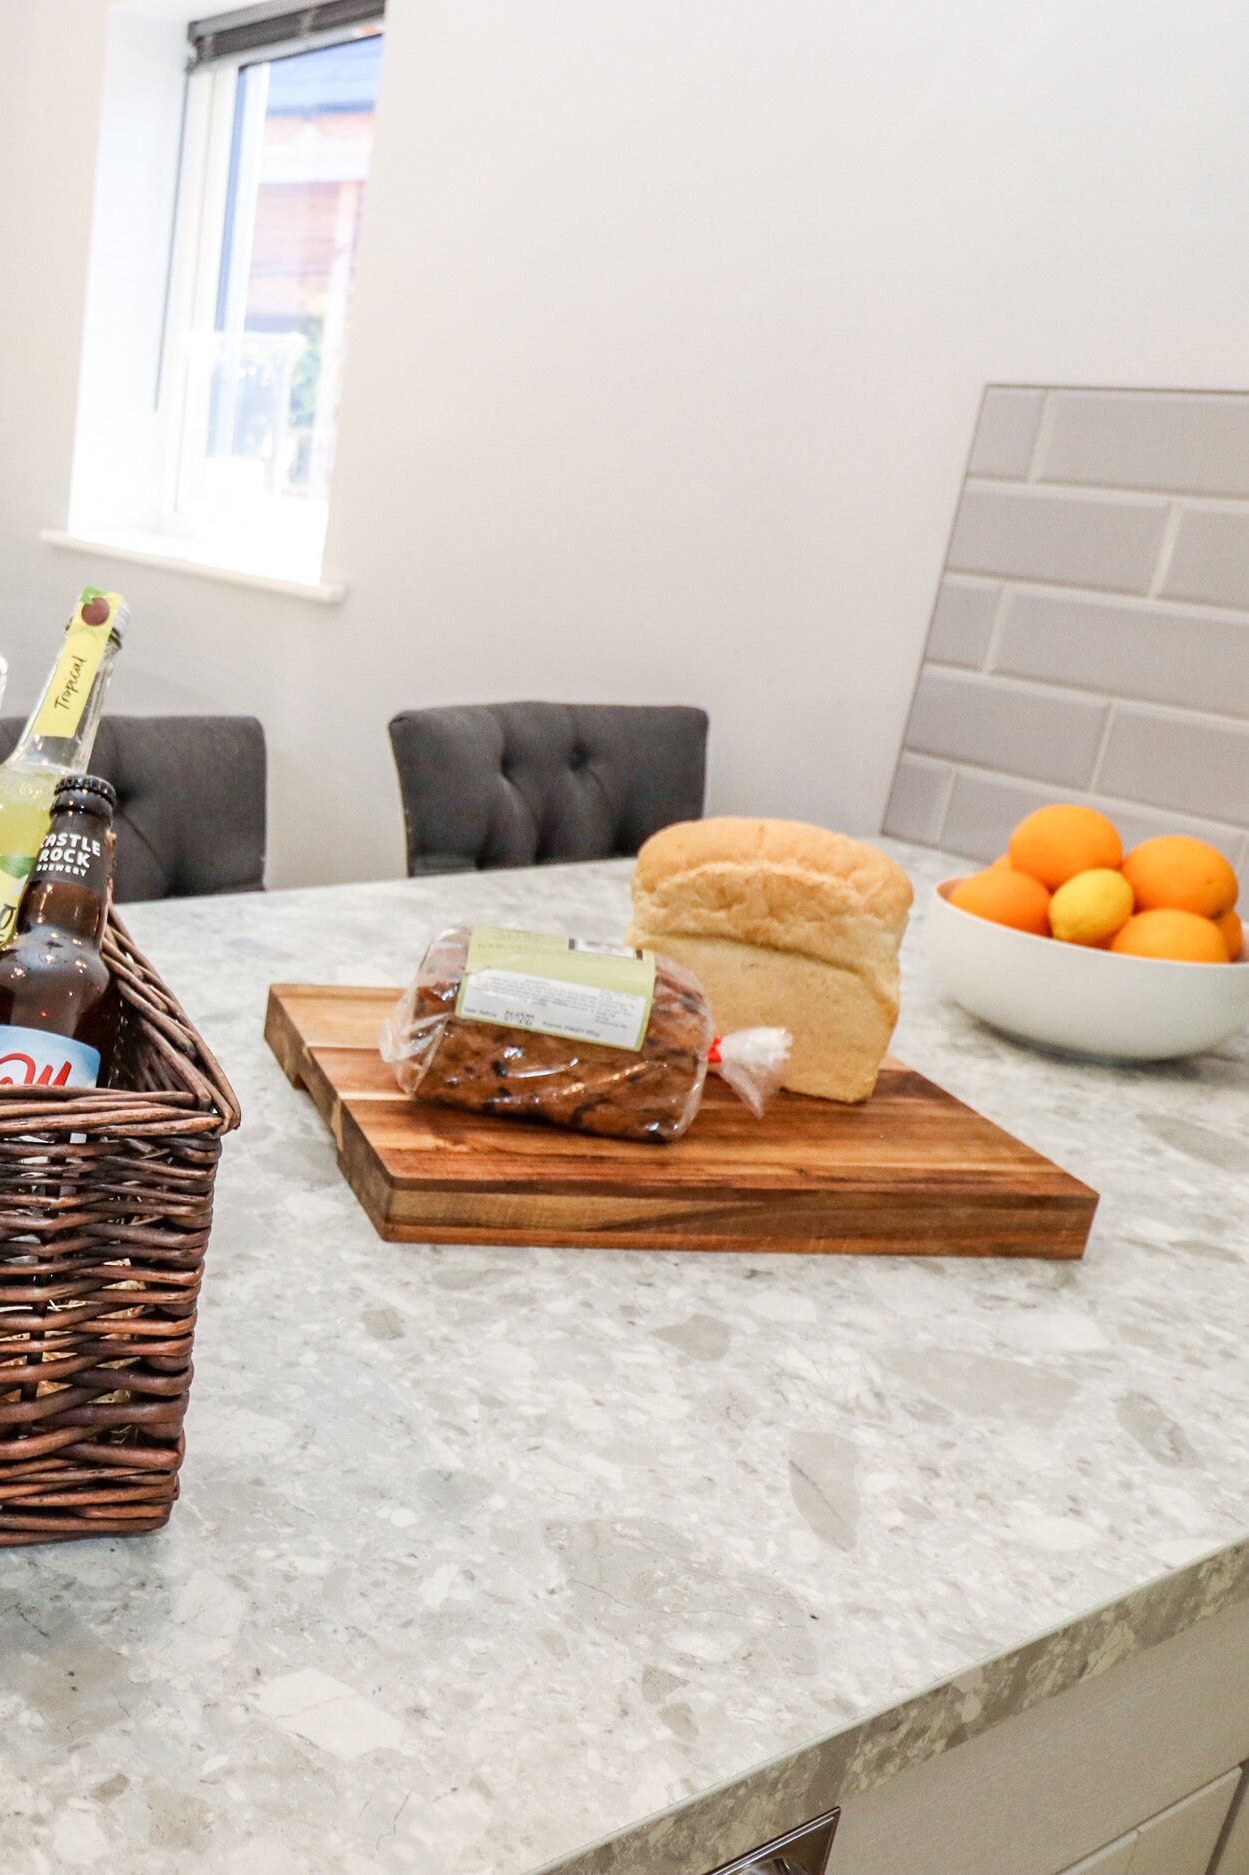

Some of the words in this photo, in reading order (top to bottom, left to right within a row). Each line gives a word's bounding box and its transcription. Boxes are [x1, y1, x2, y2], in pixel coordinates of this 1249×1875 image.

[54, 655, 87, 711] Tropical
[39, 847, 91, 869] ROCK
[36, 863, 87, 877] BREWERY
